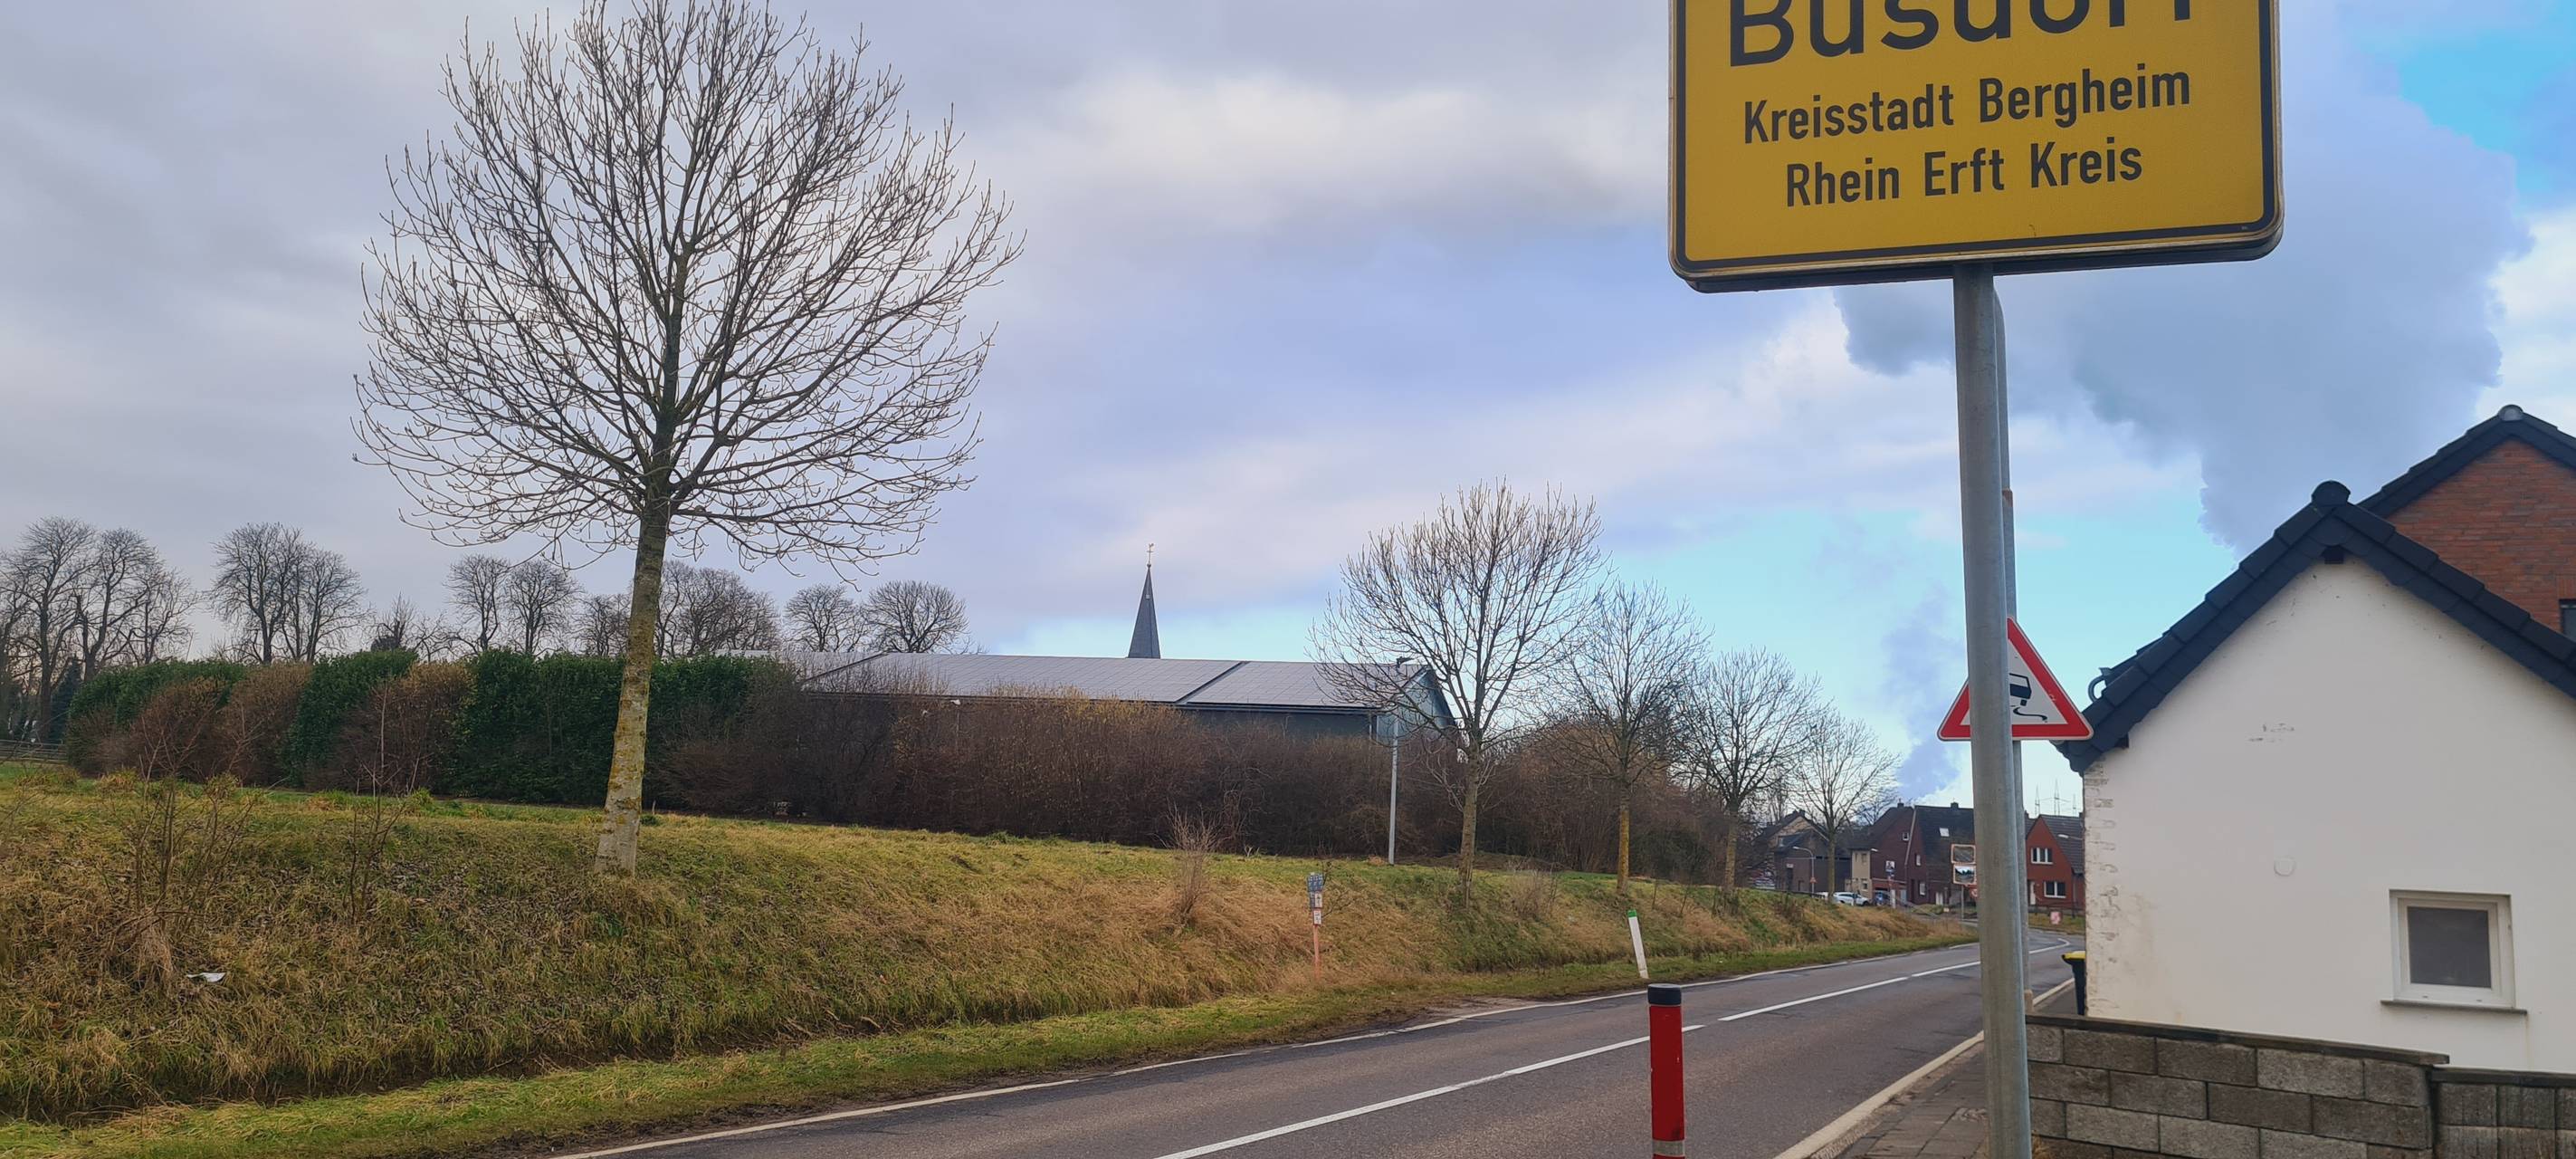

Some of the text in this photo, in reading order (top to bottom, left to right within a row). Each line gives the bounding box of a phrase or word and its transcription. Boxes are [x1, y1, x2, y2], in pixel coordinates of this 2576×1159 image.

[1730, 0, 2191, 67] Buso
[1744, 63, 2191, 145] Kreisstadt Bergheim
[1787, 137, 2144, 207] Rhein Erft Kreis
